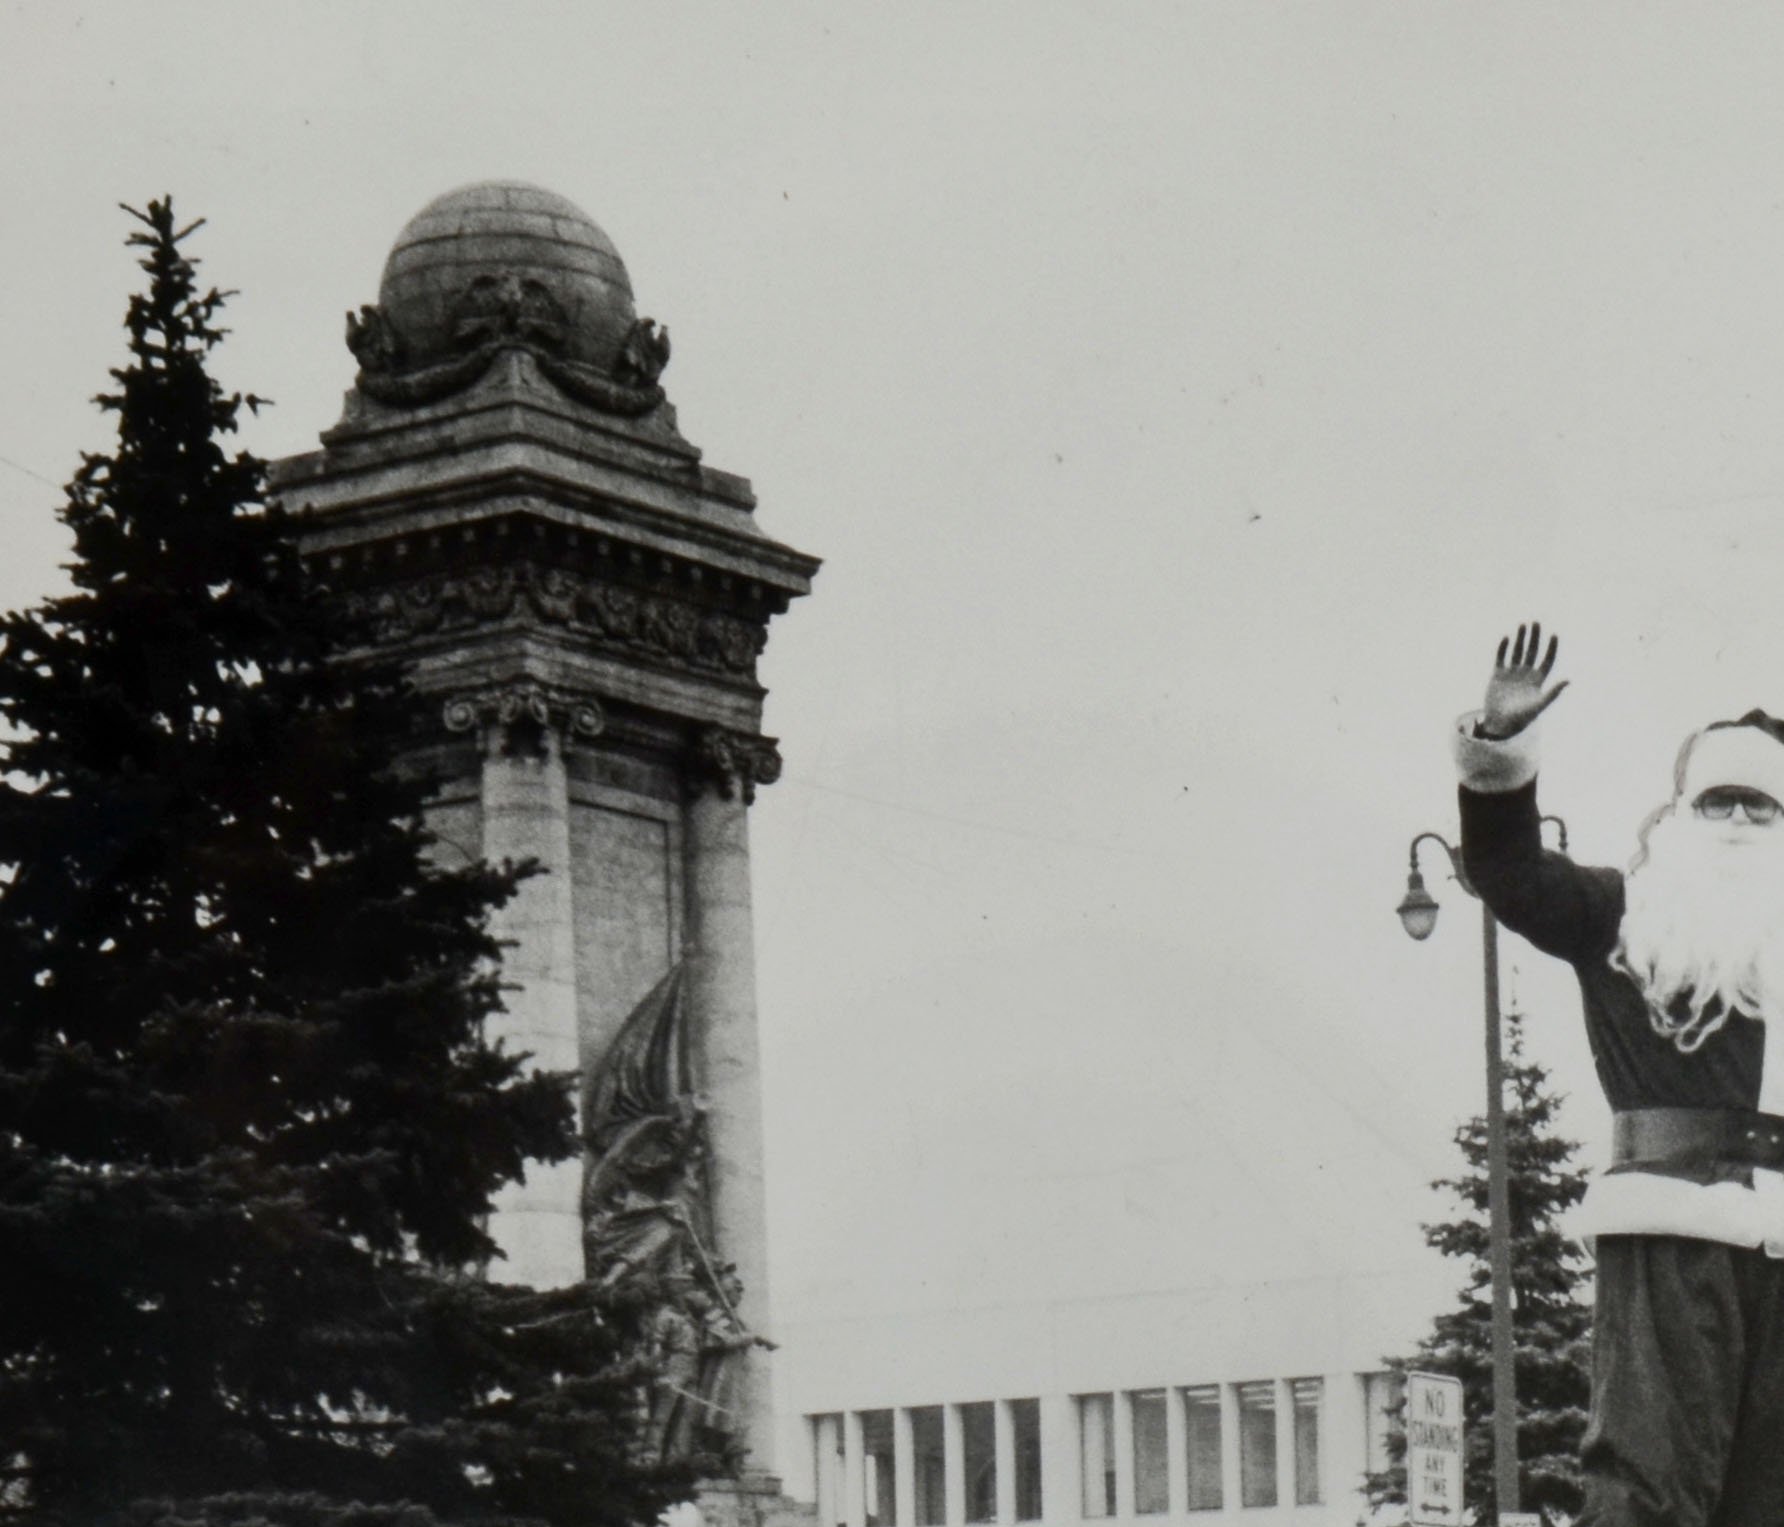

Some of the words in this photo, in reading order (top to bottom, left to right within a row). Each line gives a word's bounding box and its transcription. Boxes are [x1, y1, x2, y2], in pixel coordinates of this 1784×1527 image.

[1424, 1388, 1445, 1418] NO
[1412, 1420, 1459, 1453] STANDING
[1424, 1453, 1445, 1474] ANY
[1423, 1475, 1448, 1498] TIME
